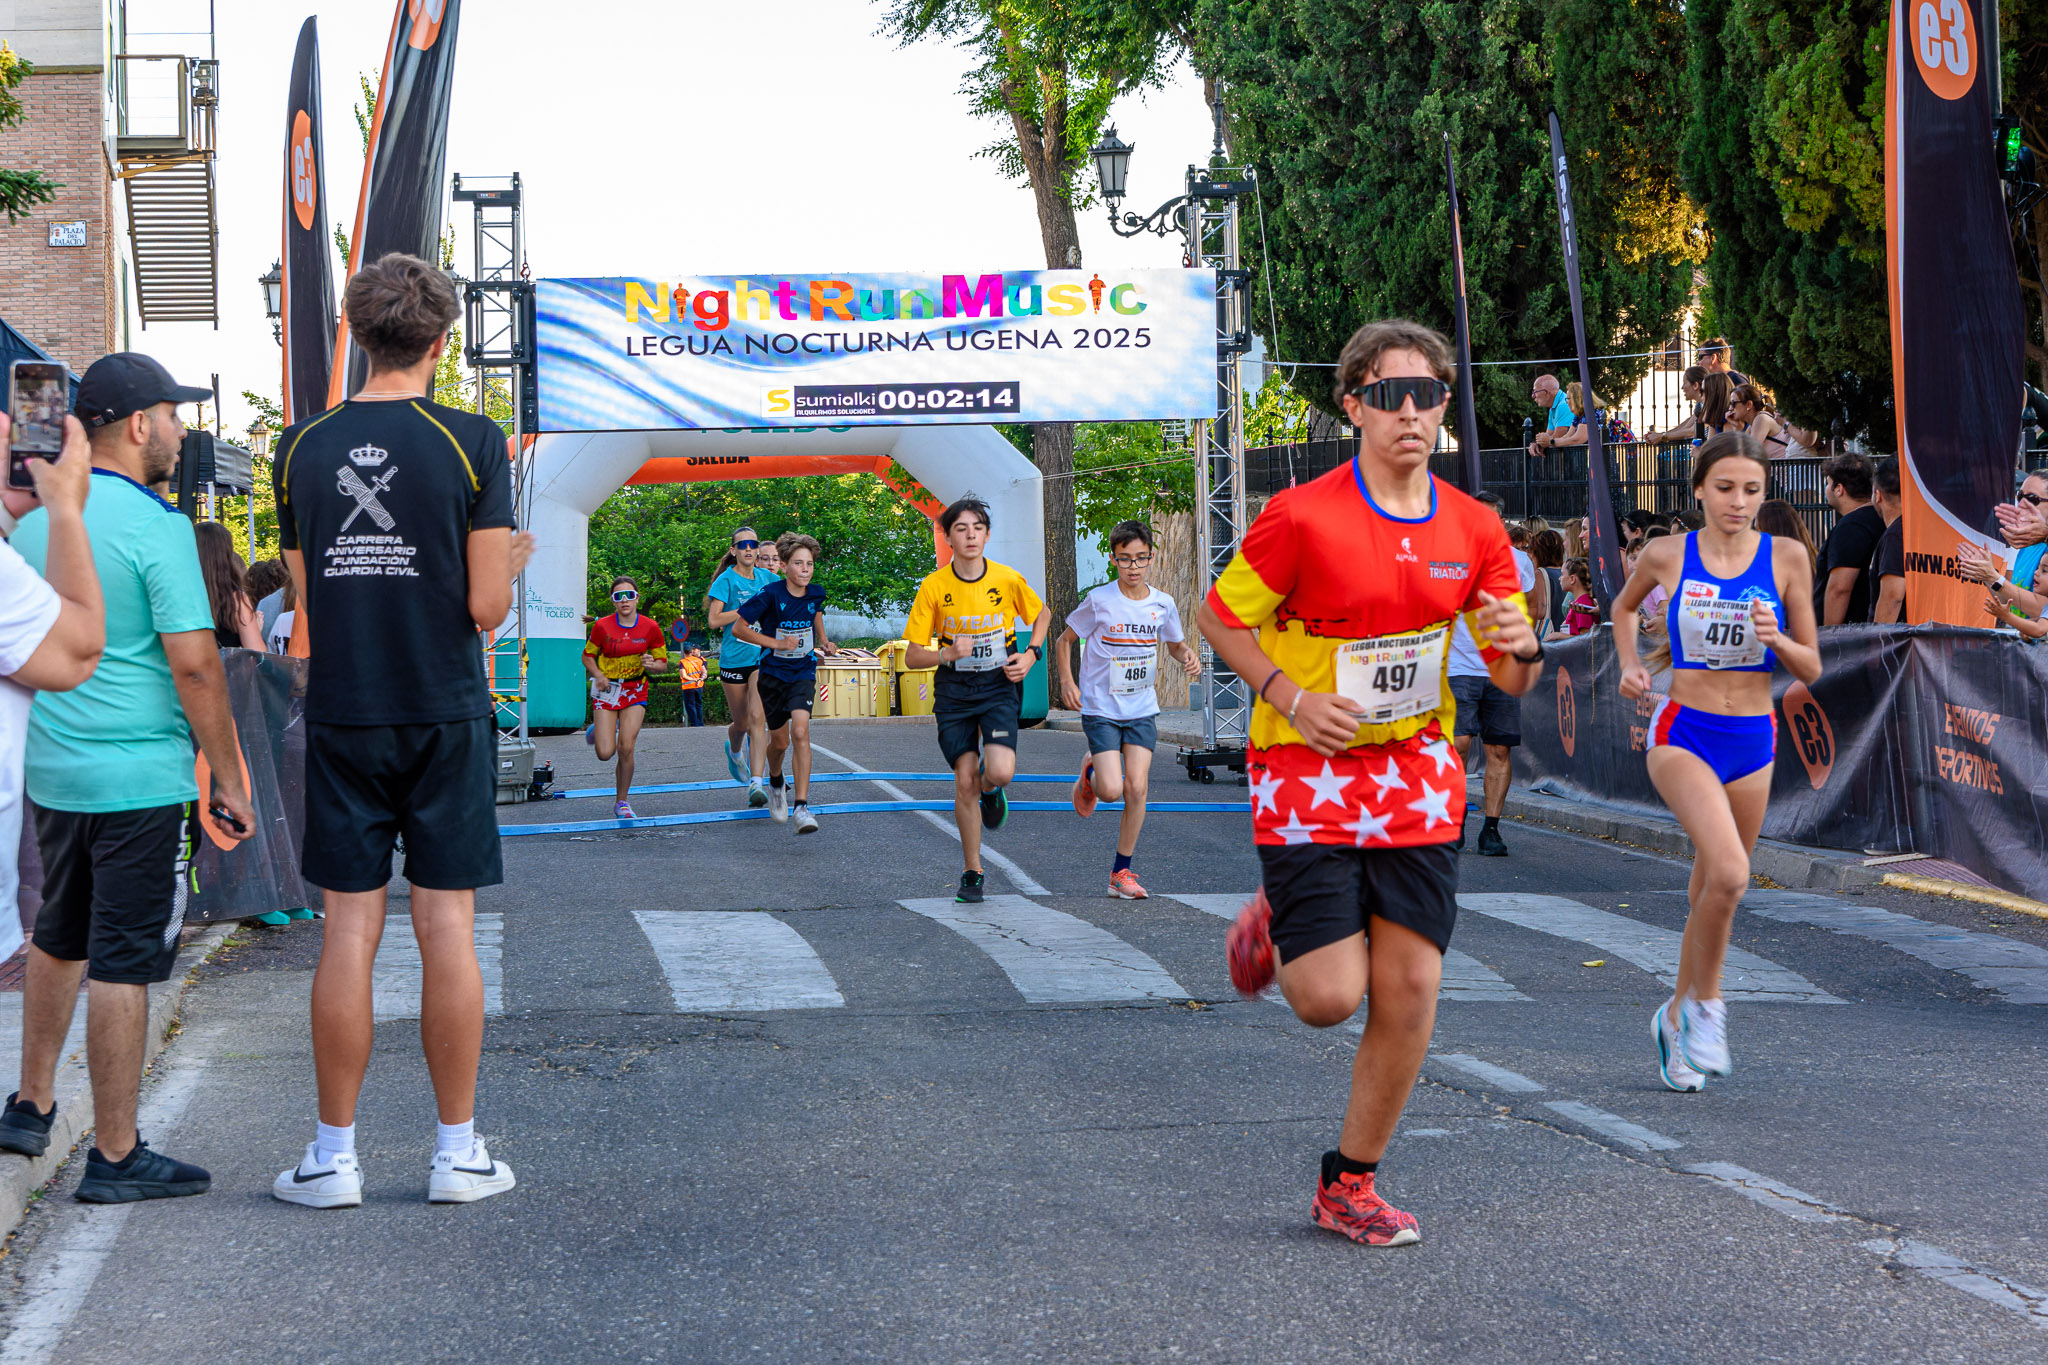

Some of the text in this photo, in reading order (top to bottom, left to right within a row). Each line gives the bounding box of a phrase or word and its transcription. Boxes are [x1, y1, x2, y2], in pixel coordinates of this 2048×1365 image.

[1919, 0, 1969, 76] e3
[54, 238, 82, 246] PALACIO
[626, 327, 1151, 357] LEGUA NOCTURNA UGENA 2025
[796, 391, 876, 407] sumialki
[878, 388, 1014, 410] 00:02:14
[336, 535, 404, 545] CARRERA
[325, 546, 417, 556] ANIVERSARIO
[332, 555, 410, 566] FUNDACIÓN
[324, 566, 420, 576] GUARDIA CIVIL
[1690, 599, 1711, 608] LEGUA
[1711, 601, 1749, 611] NOCTURNA
[544, 611, 575, 619] TOLEDO
[959, 612, 1004, 630] TEAM
[1705, 622, 1745, 647] 476
[972, 644, 993, 659] 475
[1351, 641, 1376, 652] LEGUA
[1378, 637, 1420, 649] NOCTURNA
[720, 669, 744, 680] NIKE
[1125, 666, 1147, 681] 486
[1372, 661, 1418, 693] 497
[1560, 684, 1573, 739] e3
[1793, 702, 1831, 767] e3
